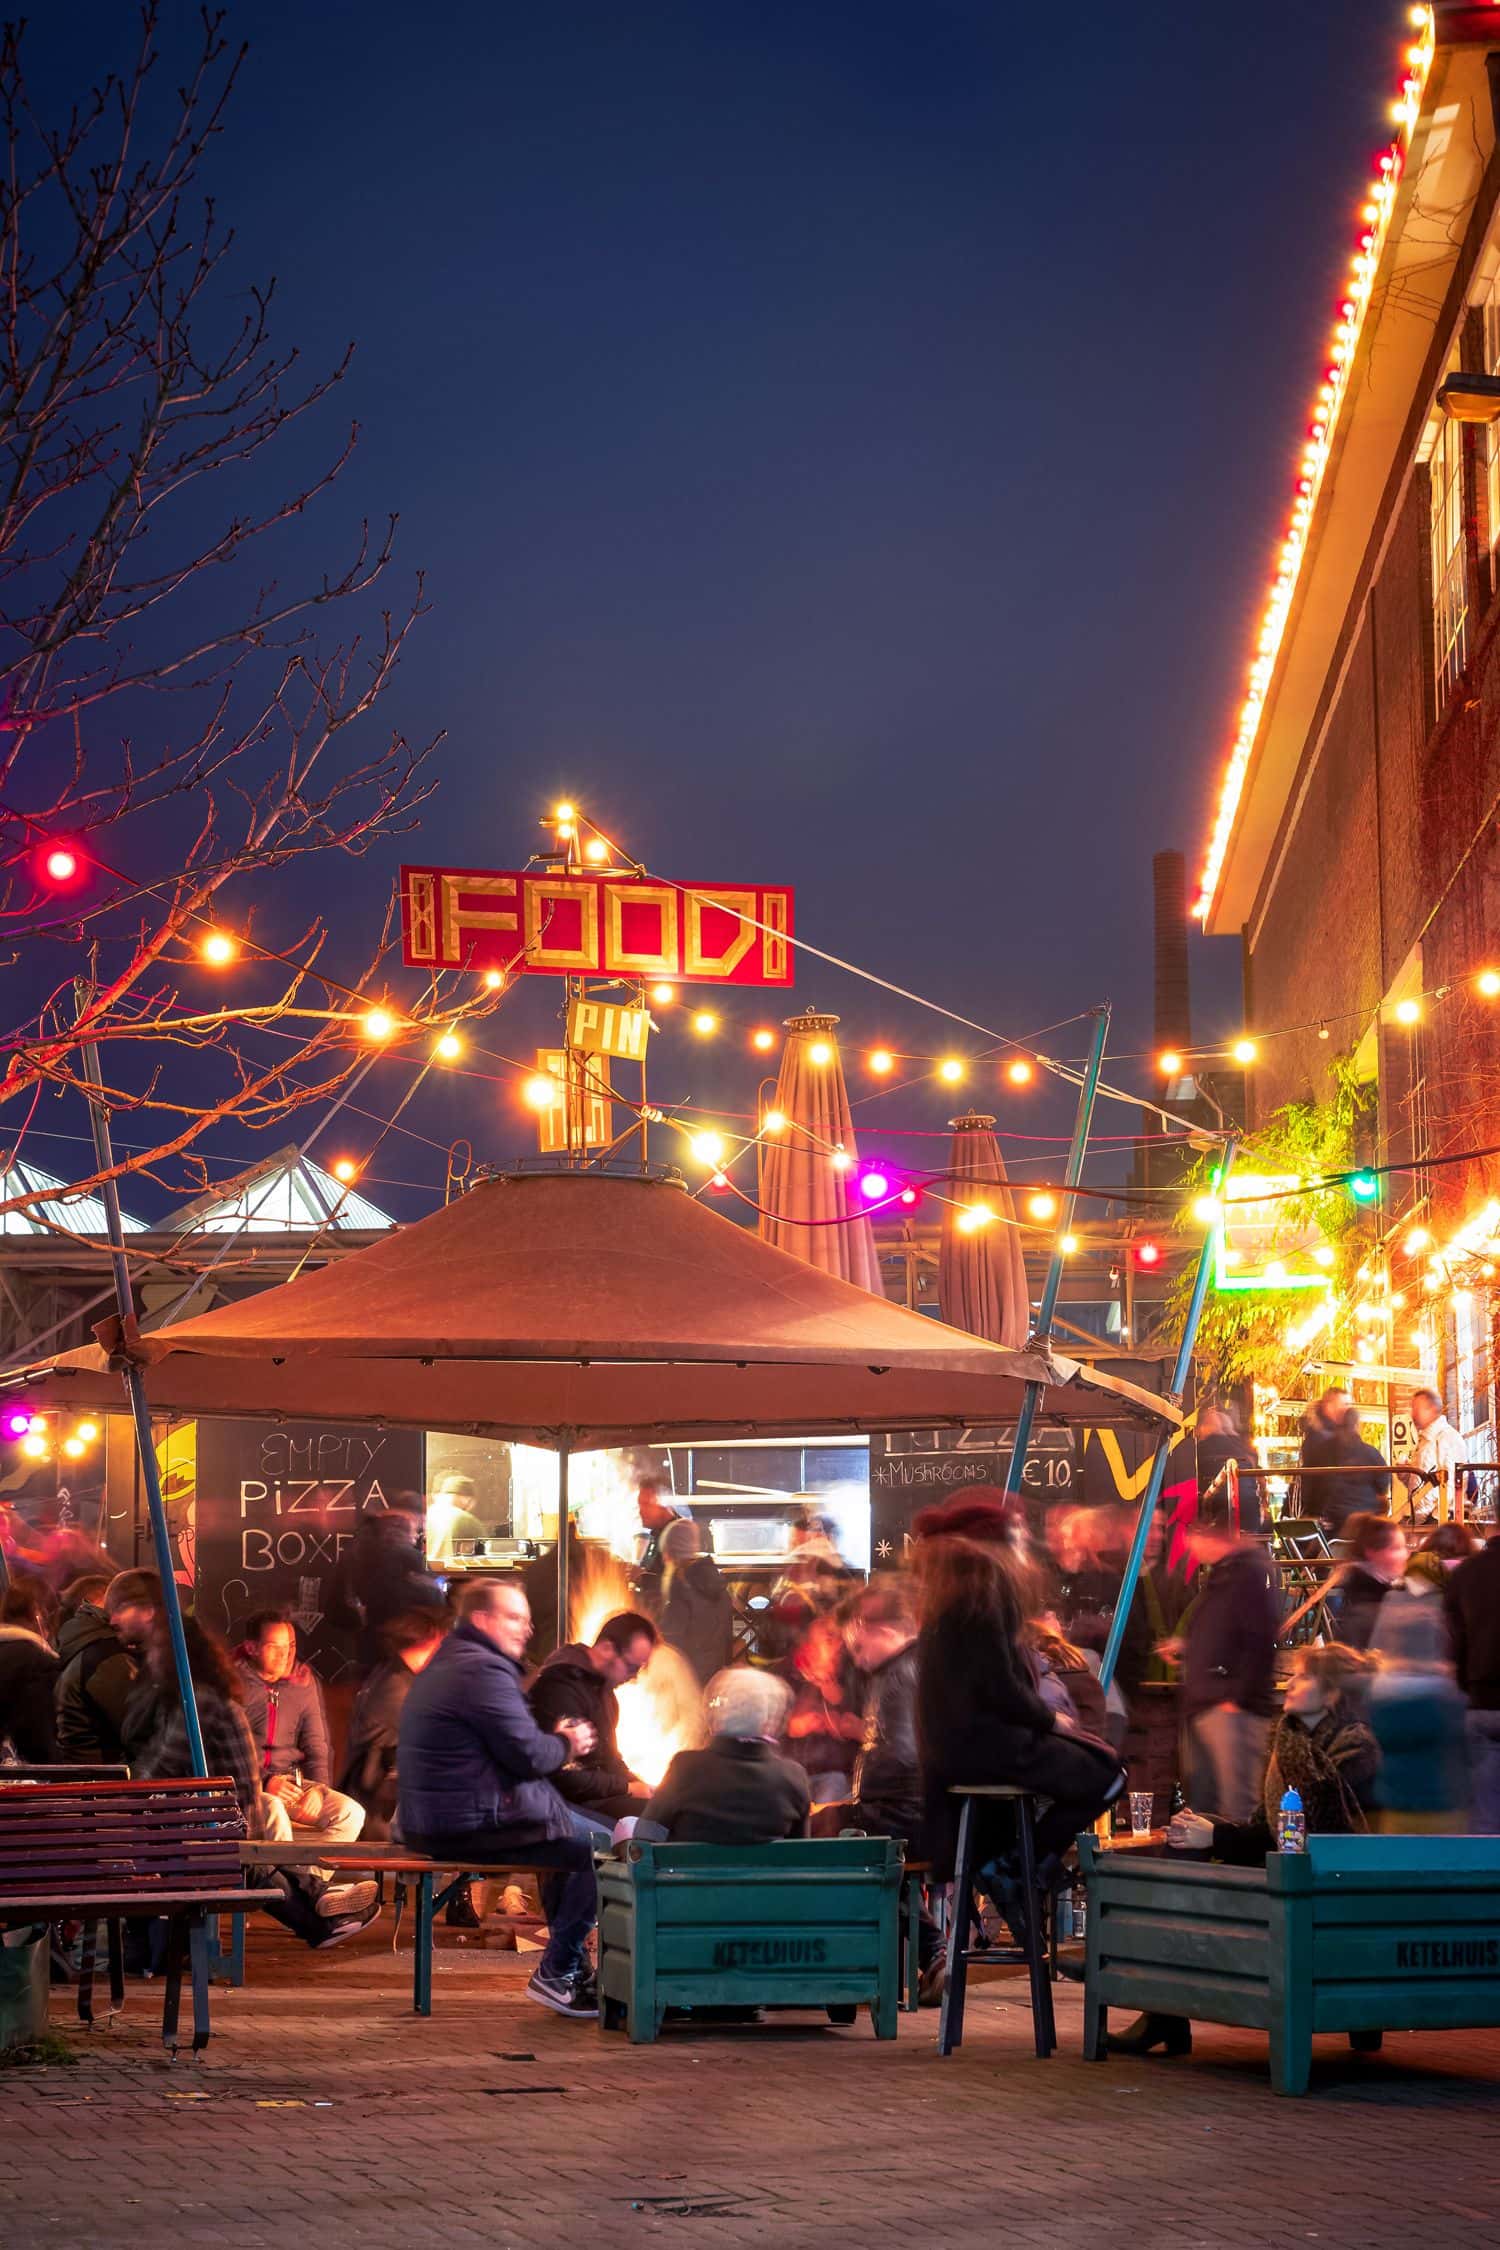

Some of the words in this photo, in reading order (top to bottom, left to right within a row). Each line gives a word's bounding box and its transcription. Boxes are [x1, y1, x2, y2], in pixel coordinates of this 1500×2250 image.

[440, 874, 757, 976] FOOD
[573, 1002, 642, 1056] PIN
[260, 1433, 387, 1479] EMPTY
[712, 1937, 827, 1968] KETELHUIS
[1396, 1939, 1500, 1969] KETELHUIS
